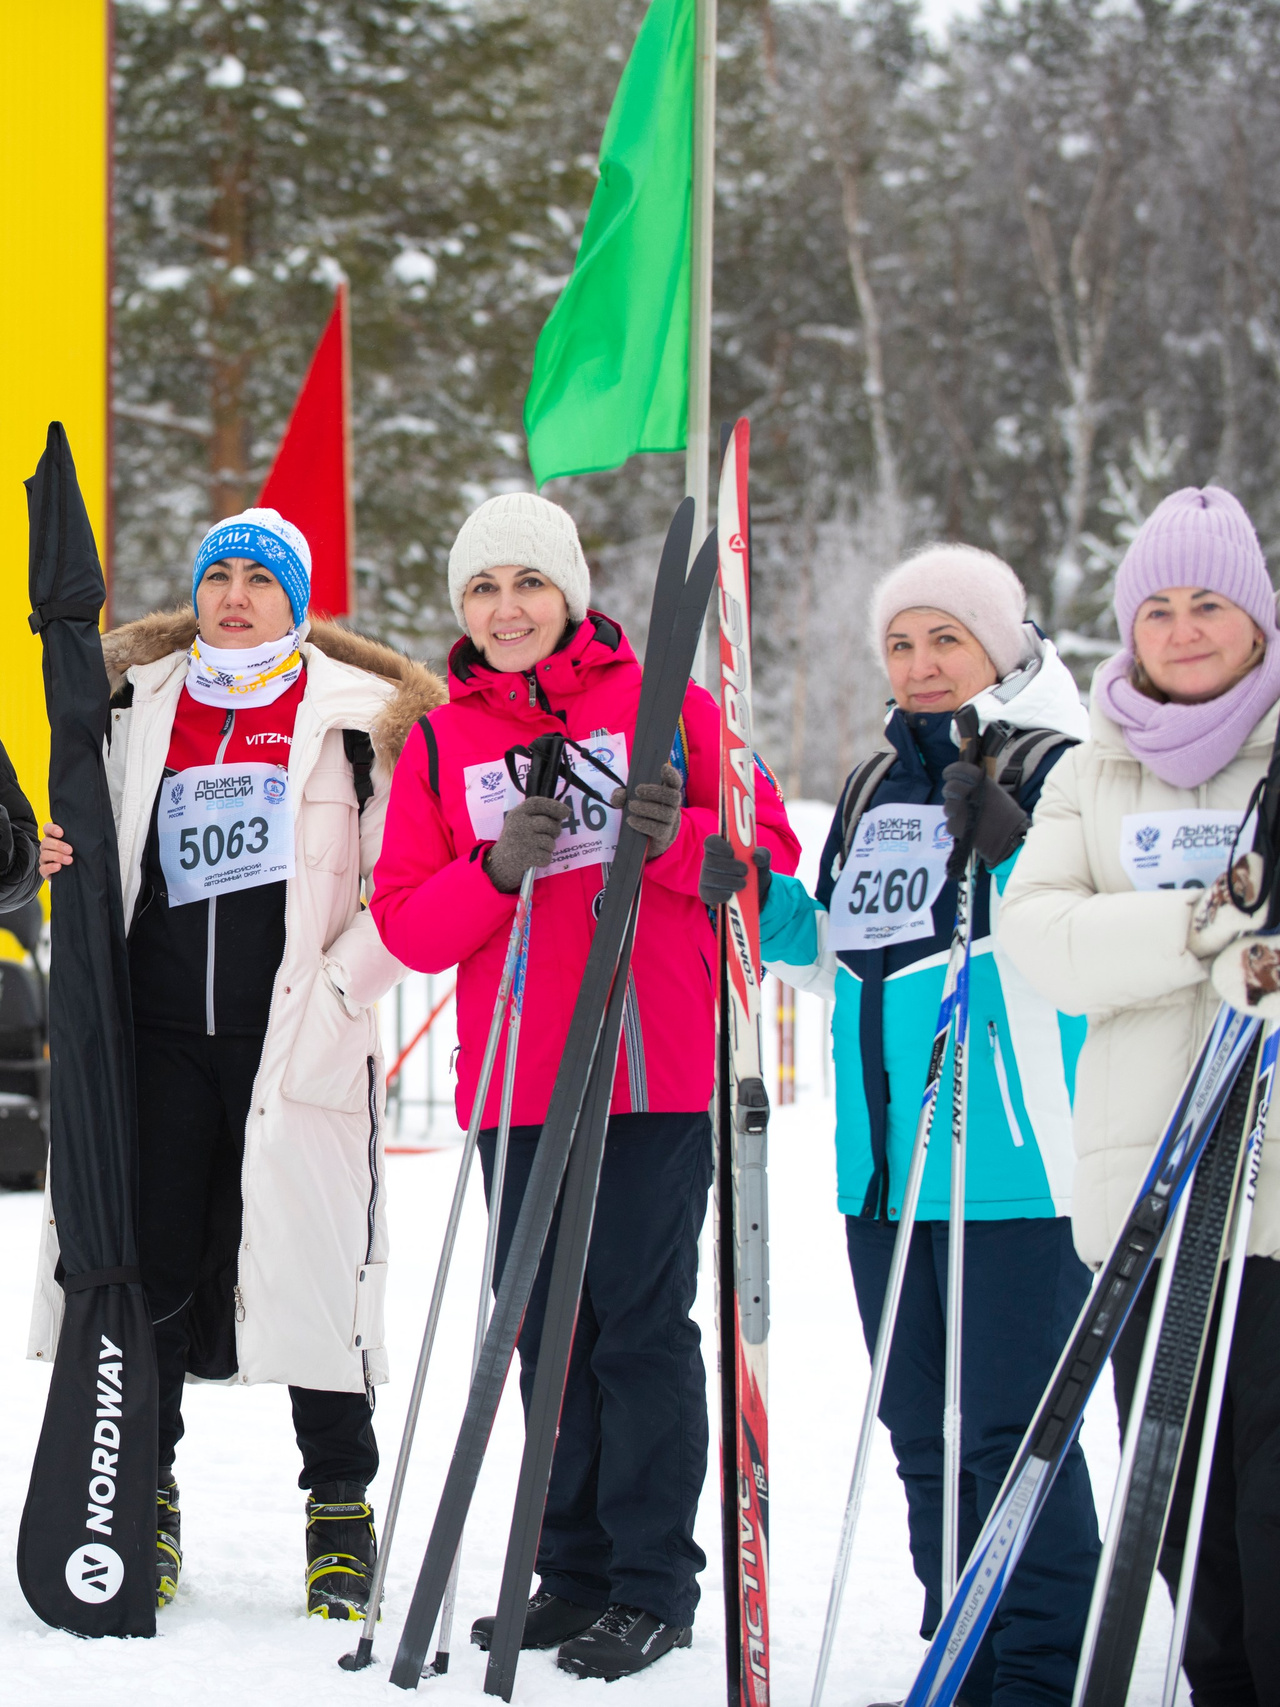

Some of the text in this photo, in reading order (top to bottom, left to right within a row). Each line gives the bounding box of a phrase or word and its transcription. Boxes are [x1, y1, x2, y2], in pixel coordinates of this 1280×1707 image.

[194, 531, 251, 573] ОССИИ
[194, 785, 254, 802] РОССИИ
[196, 775, 252, 791] ЛЫЖНЯ
[483, 795, 504, 804] РОССИИ
[179, 816, 269, 871] 5063
[877, 829, 922, 842] ОССИИ
[879, 818, 922, 830] ЫЖНЯ
[1176, 823, 1241, 838] ЛЫЖНЯ
[848, 866, 929, 915] 5260
[729, 905, 754, 986] COMBI
[952, 1041, 964, 1145] SPRINT
[86, 1334, 123, 1536] NORDWAY
[752, 1461, 768, 1501] 185
